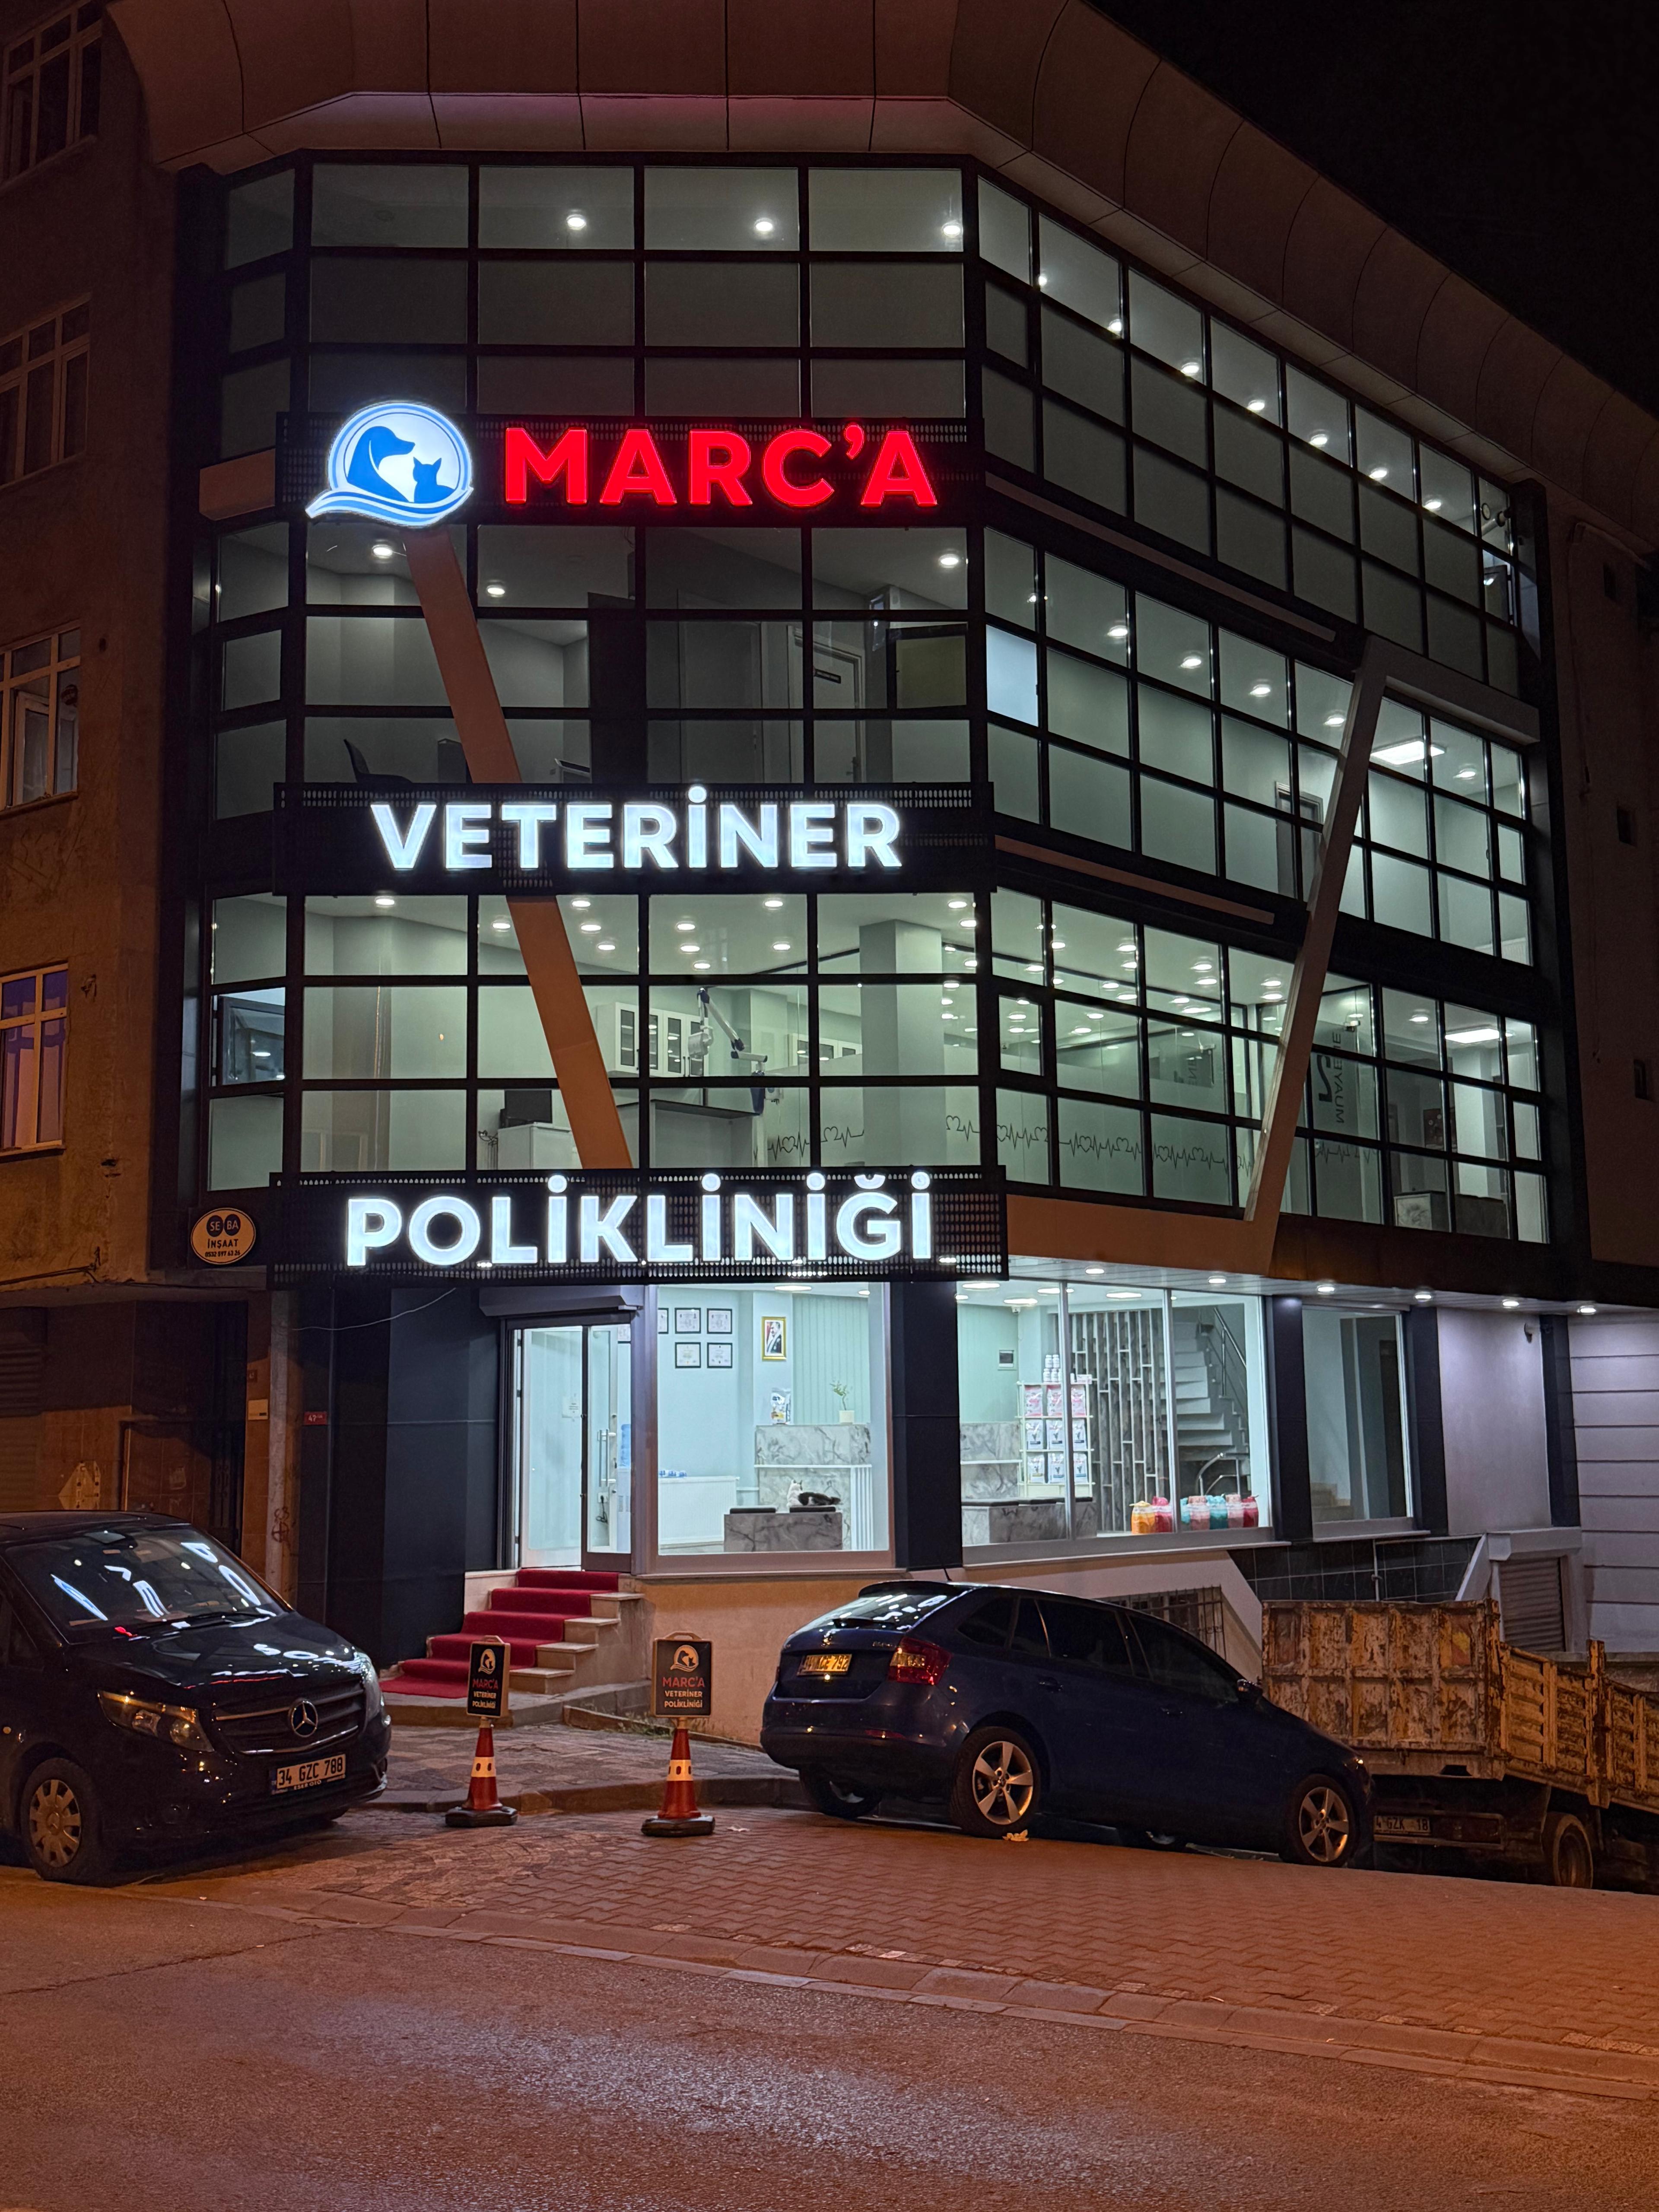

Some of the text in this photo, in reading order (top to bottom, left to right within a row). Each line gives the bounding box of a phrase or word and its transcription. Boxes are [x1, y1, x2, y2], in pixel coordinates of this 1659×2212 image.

[505, 423, 938, 506] MARC'A
[370, 786, 902, 869] VETERİNER
[346, 1173, 933, 1267] POLİKLİNİĞİ
[207, 1239, 238, 1249] İNŞAAT
[664, 1699, 702, 1708] POLİKLİNİĞİ
[665, 1689, 702, 1697] VETERİNER
[279, 1769, 292, 1786] 34
[299, 1763, 319, 1782] GZC
[324, 1757, 343, 1776] 788
